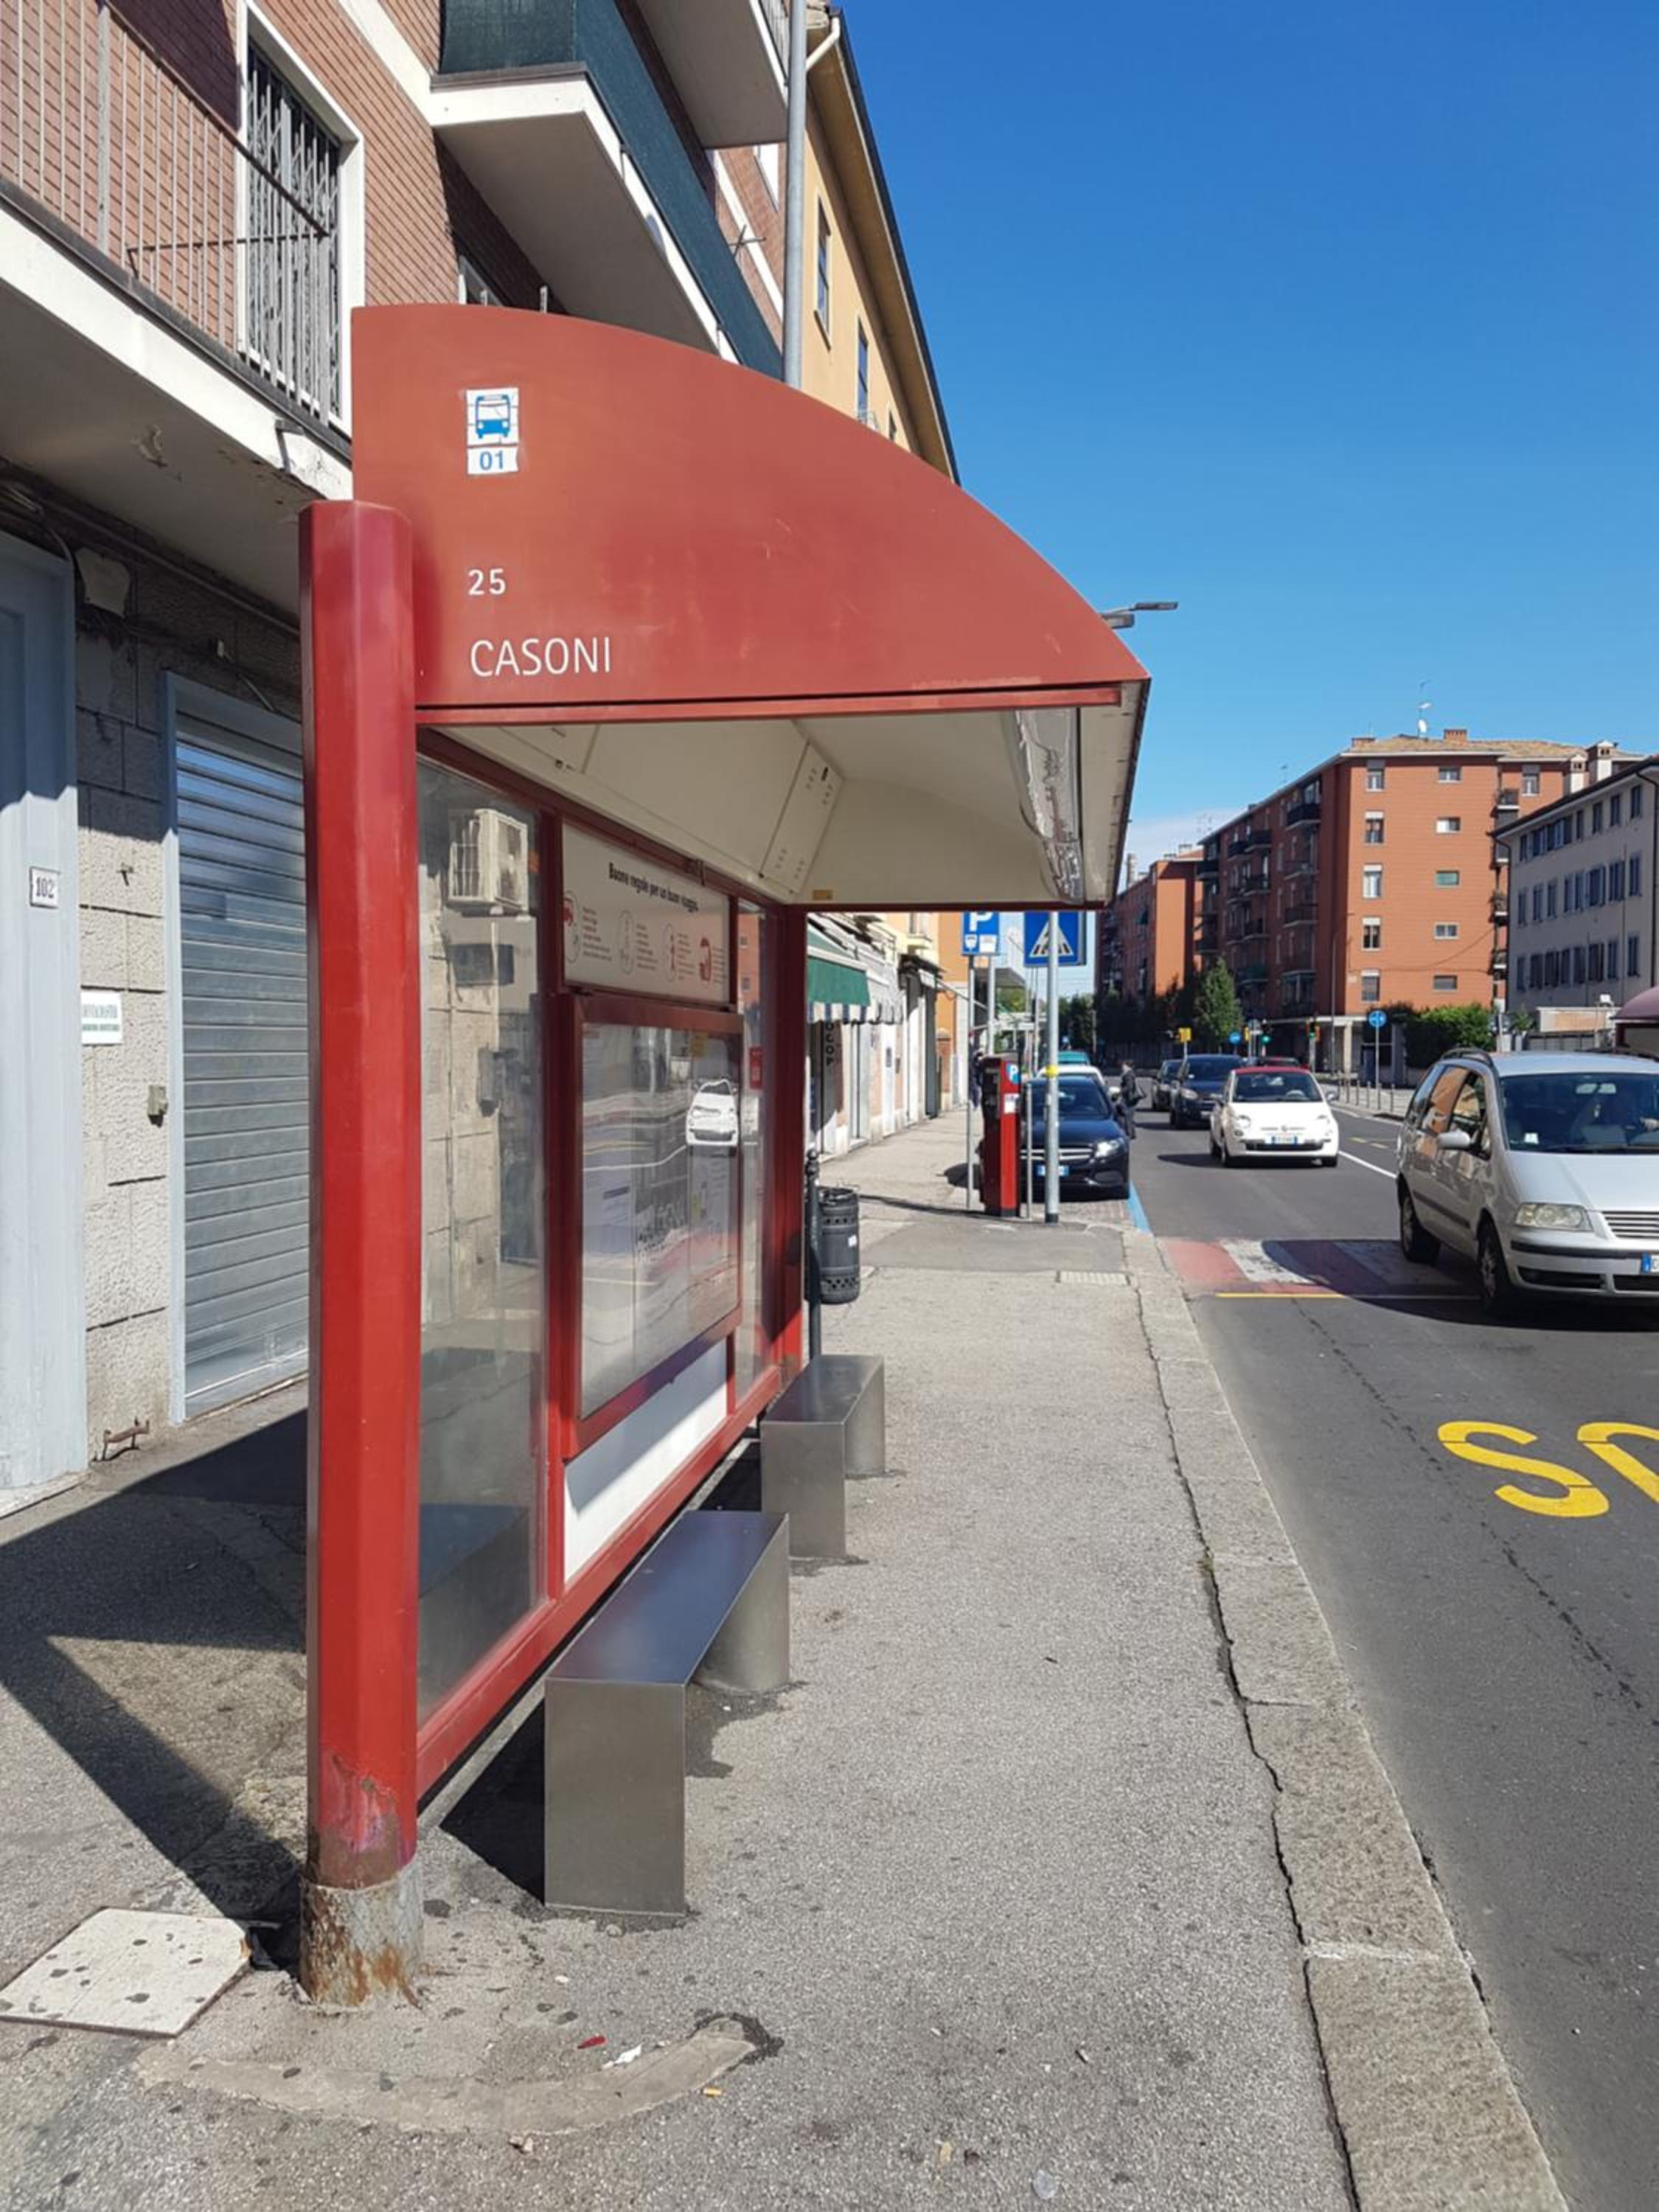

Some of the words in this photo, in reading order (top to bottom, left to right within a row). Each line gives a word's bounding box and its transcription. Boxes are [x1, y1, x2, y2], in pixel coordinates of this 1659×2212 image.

[479, 450, 504, 470] 01
[467, 568, 507, 596] 25
[470, 636, 611, 677] CASONI
[35, 877, 55, 899] 102
